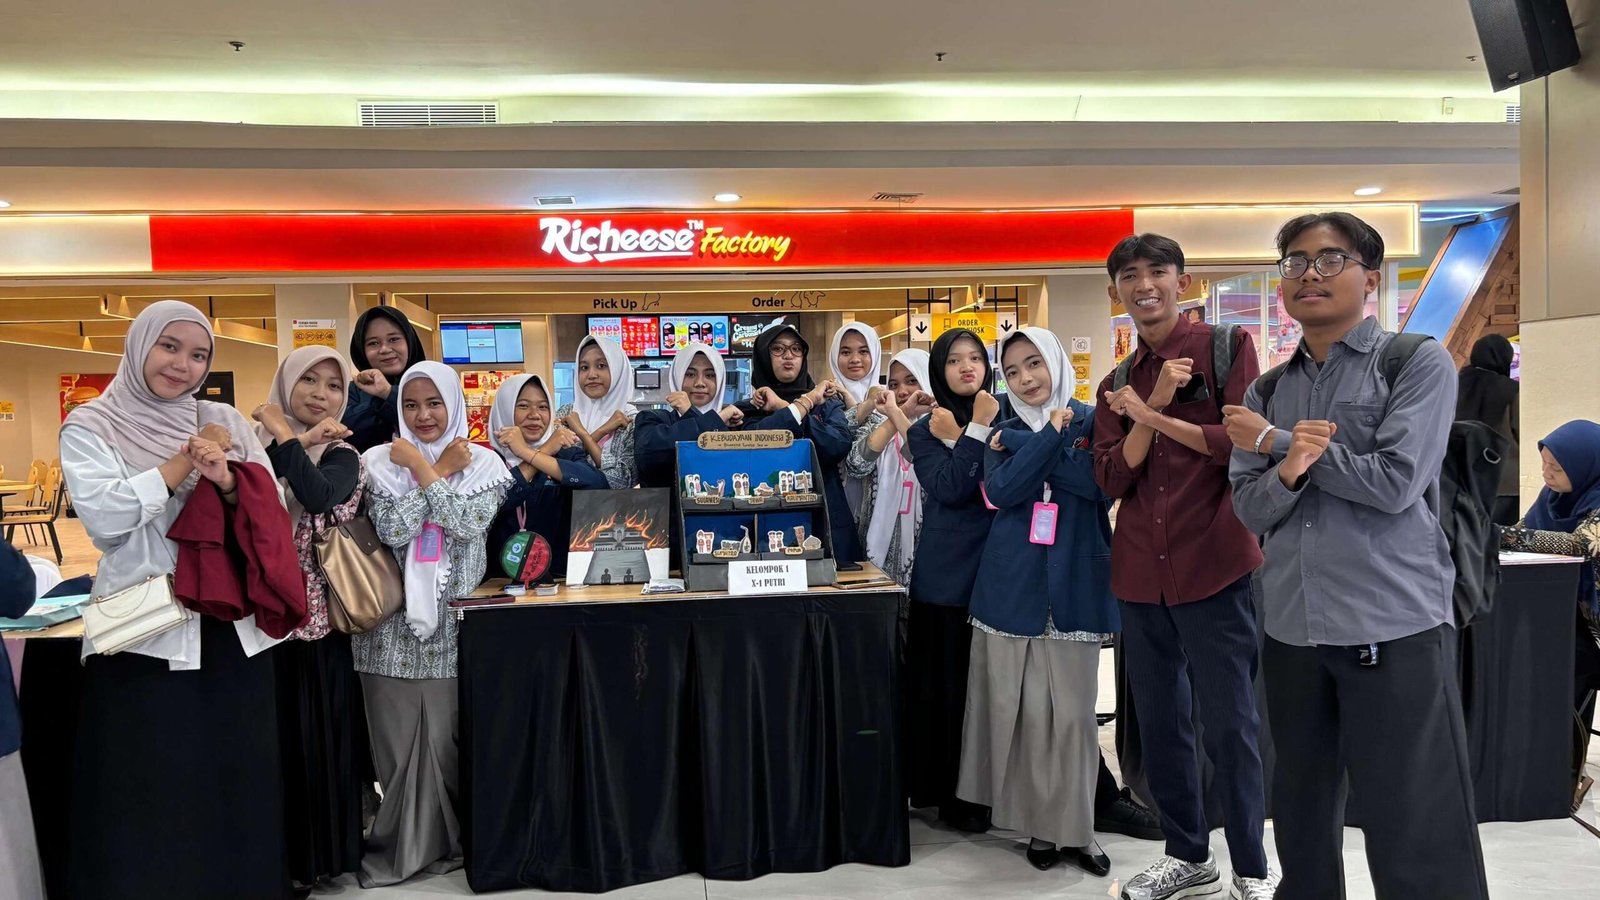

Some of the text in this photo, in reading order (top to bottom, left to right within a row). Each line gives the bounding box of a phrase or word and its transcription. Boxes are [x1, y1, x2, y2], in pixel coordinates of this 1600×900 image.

[539, 216, 791, 263] Richeese TM Factory
[593, 298, 637, 312] Pick Up
[752, 297, 786, 308] Order
[710, 433, 752, 442] KEBUDAYAAN
[746, 565, 784, 574] KELOMPOK
[751, 578, 786, 588] X-1 PUTRI
